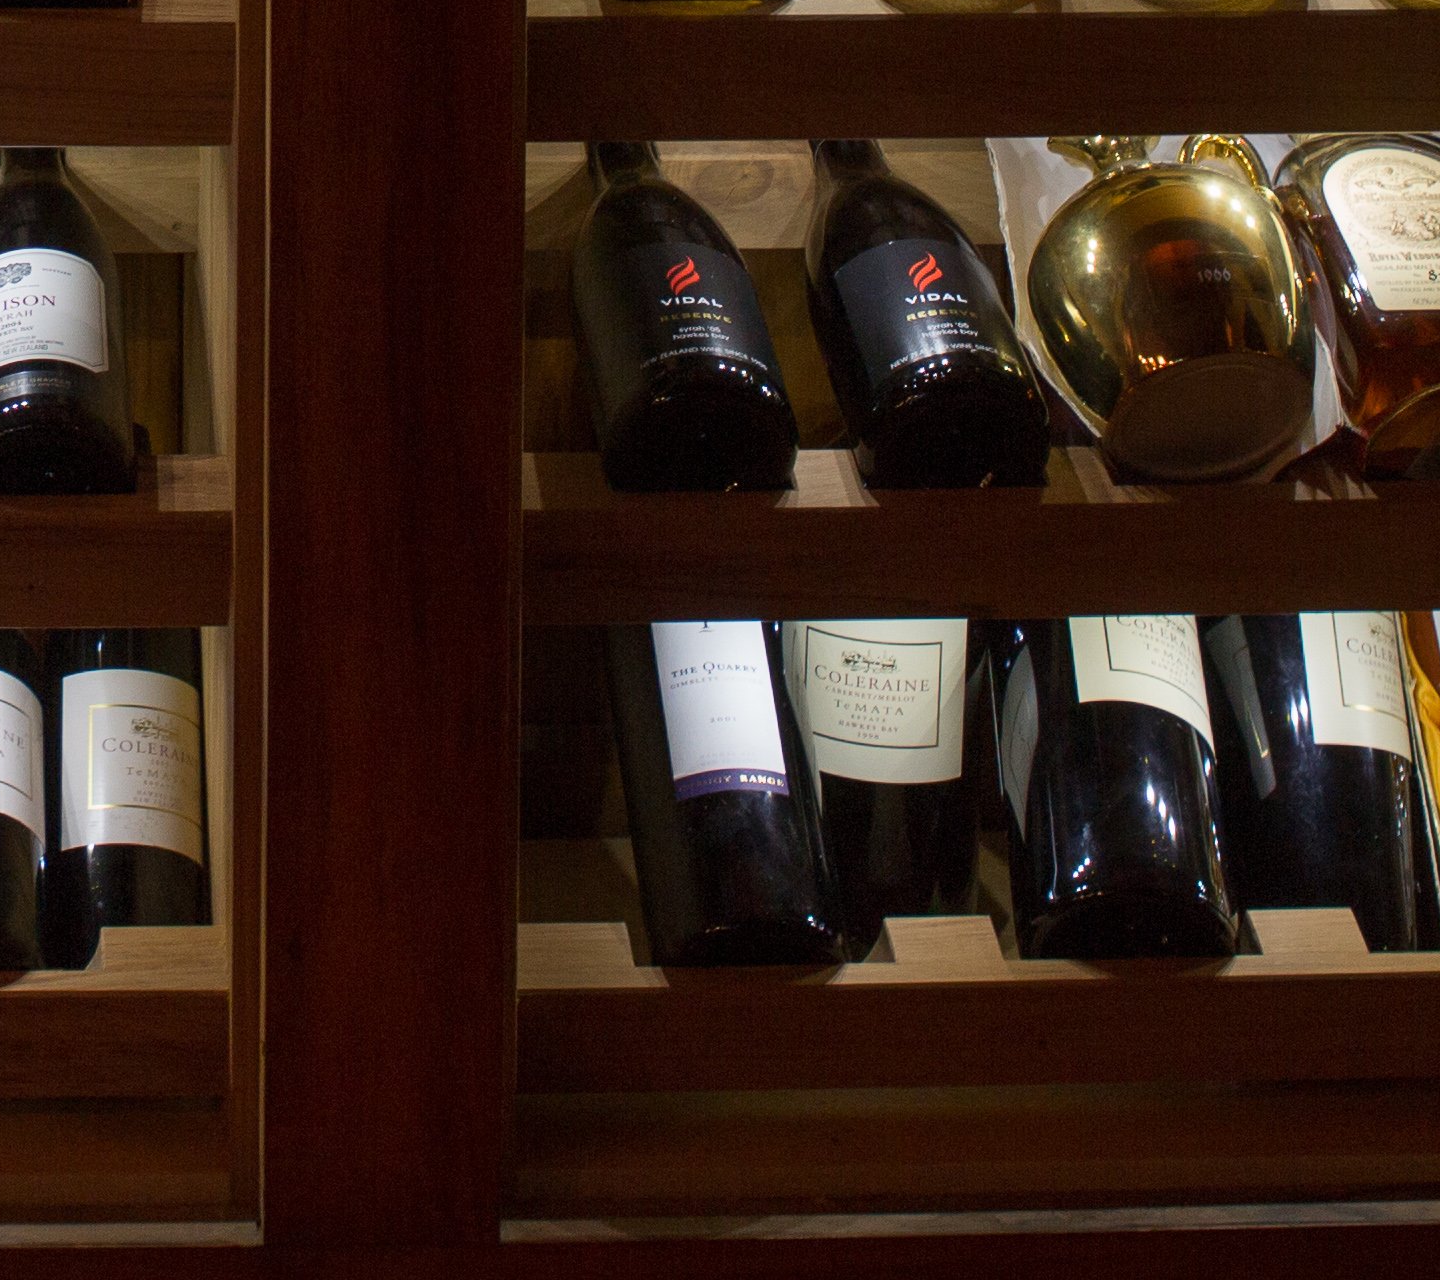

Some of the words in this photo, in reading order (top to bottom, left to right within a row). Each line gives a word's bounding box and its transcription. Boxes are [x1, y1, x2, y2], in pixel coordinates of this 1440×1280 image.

[659, 296, 724, 308] VIDAL
[904, 293, 968, 306] VIDAL
[905, 308, 979, 322] RESERVE
[669, 667, 698, 679] THE
[702, 661, 759, 676] QUARRY
[813, 663, 931, 693] COLERAINE
[855, 700, 905, 717] MATA
